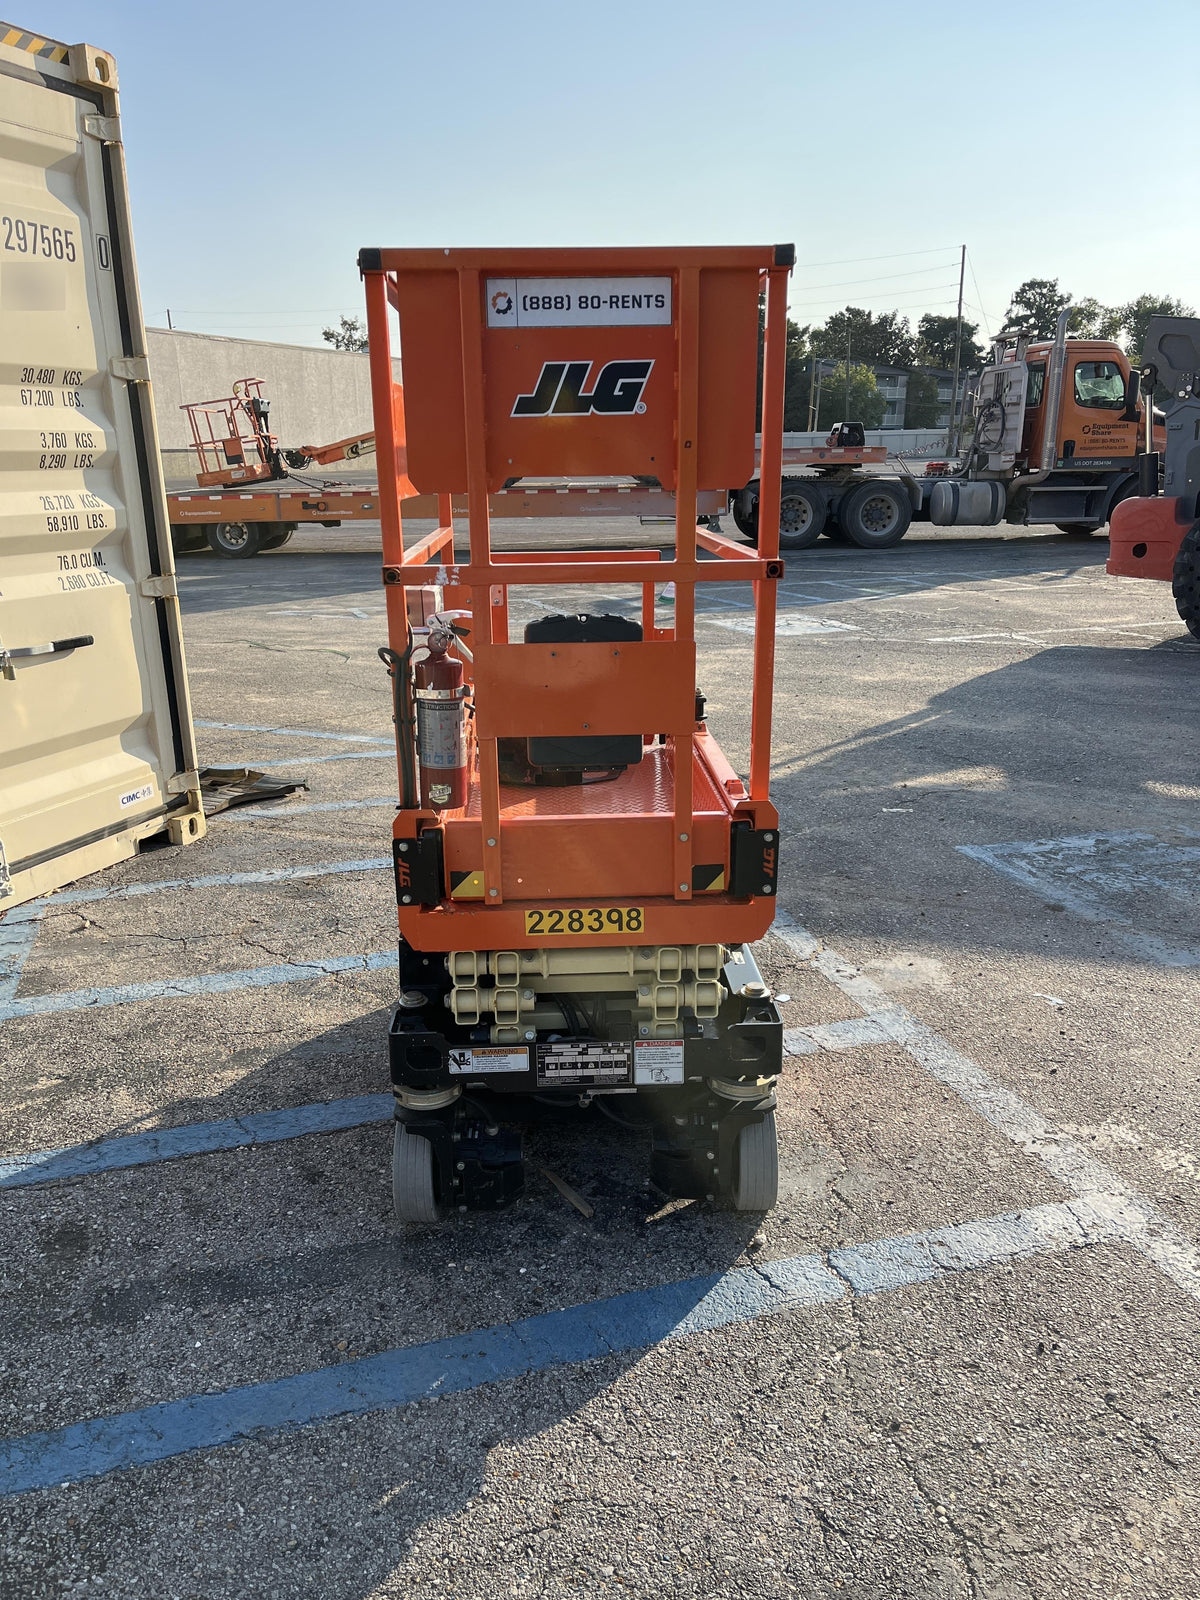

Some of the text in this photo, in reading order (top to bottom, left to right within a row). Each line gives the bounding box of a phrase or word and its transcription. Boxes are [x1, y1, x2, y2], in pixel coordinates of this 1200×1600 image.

[2, 216, 109, 270] 297565 0
[522, 294, 666, 311] (888) 80-RENTS
[21, 368, 84, 386] 30,480 KGS.
[21, 389, 84, 408] 67,200 LBS.
[40, 431, 97, 449] 3,760 KGS.
[39, 454, 94, 470] 8,290 LBS.
[40, 493, 104, 512] 26,720 KGS.
[46, 514, 108, 533] 58,910 LBS.
[57, 551, 106, 571] 76.0 CU.M.
[58, 571, 115, 592] 2,680 CU.FT.
[121, 792, 140, 804] CIMC
[763, 847, 775, 878] JLG
[397, 857, 411, 888] JLG
[527, 907, 643, 934] 228398
